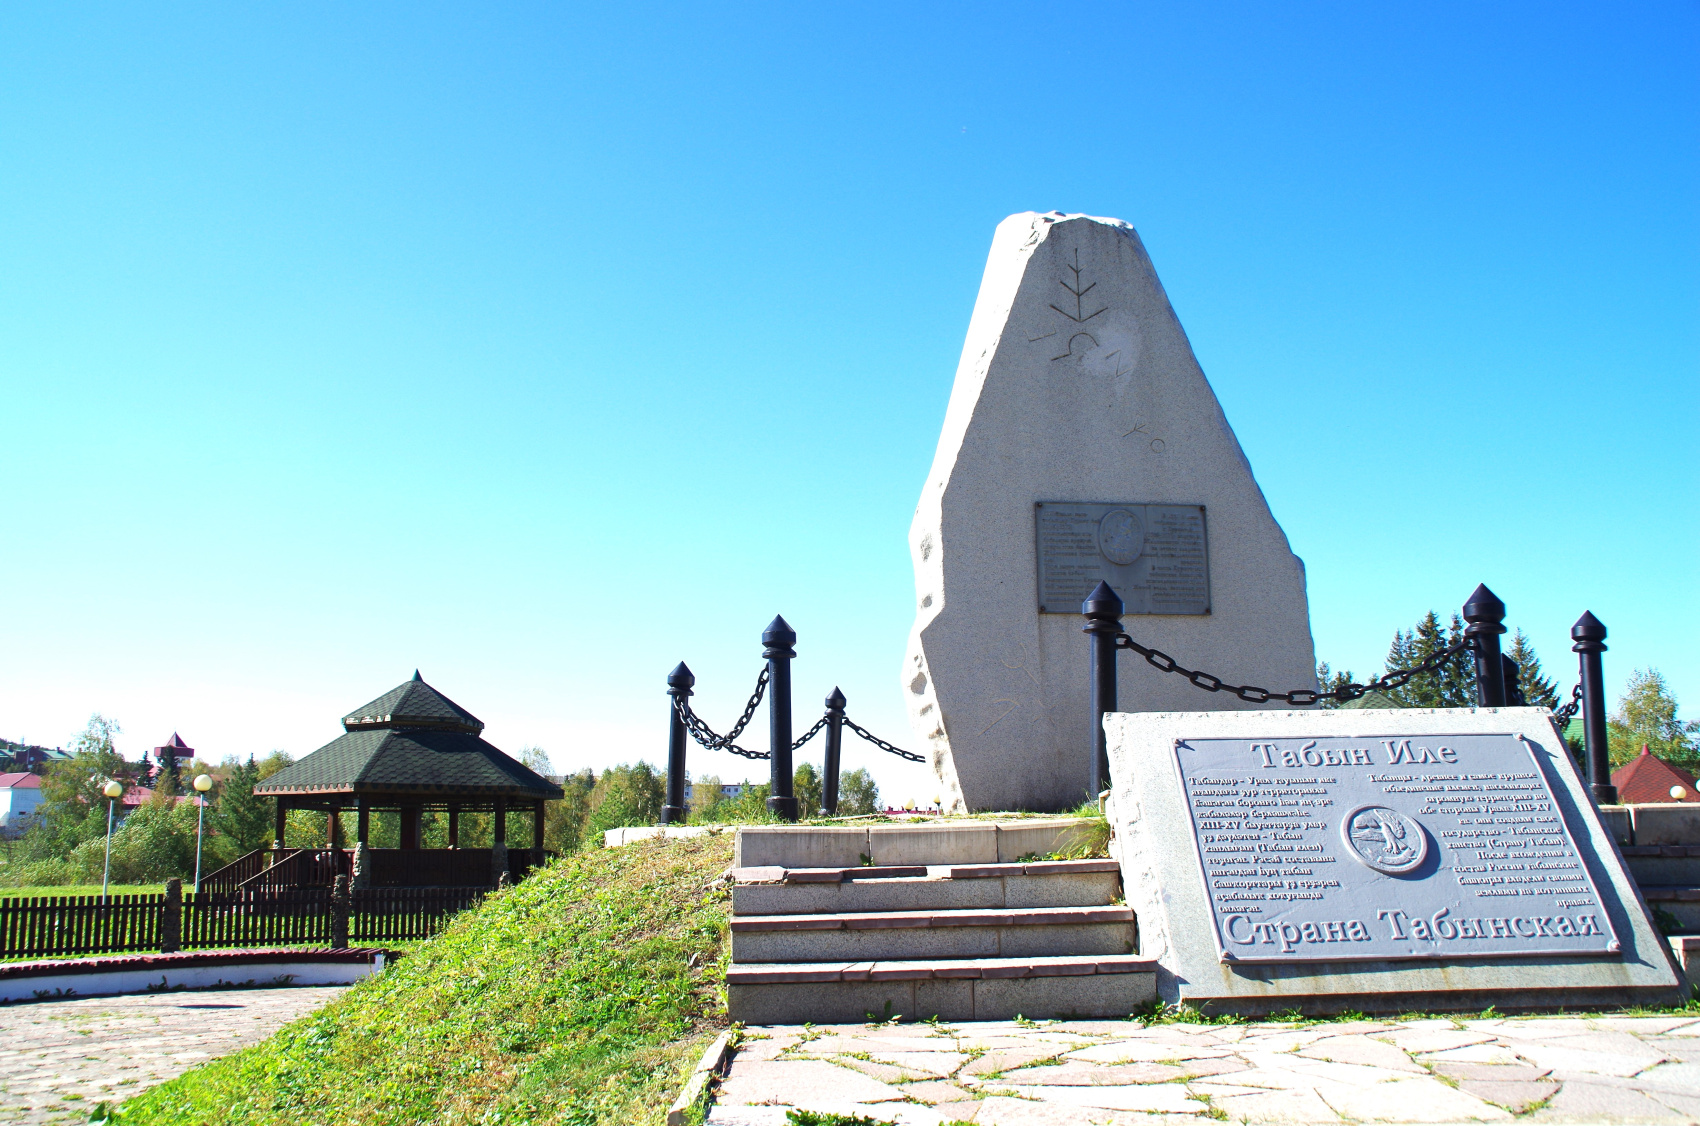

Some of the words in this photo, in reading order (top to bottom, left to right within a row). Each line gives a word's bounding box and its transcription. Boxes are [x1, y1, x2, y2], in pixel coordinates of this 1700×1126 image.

[1250, 740, 1375, 768] Табын
[1380, 739, 1459, 764] Иле
[1223, 914, 1370, 953] Страна
[1376, 906, 1603, 942] Табынская
